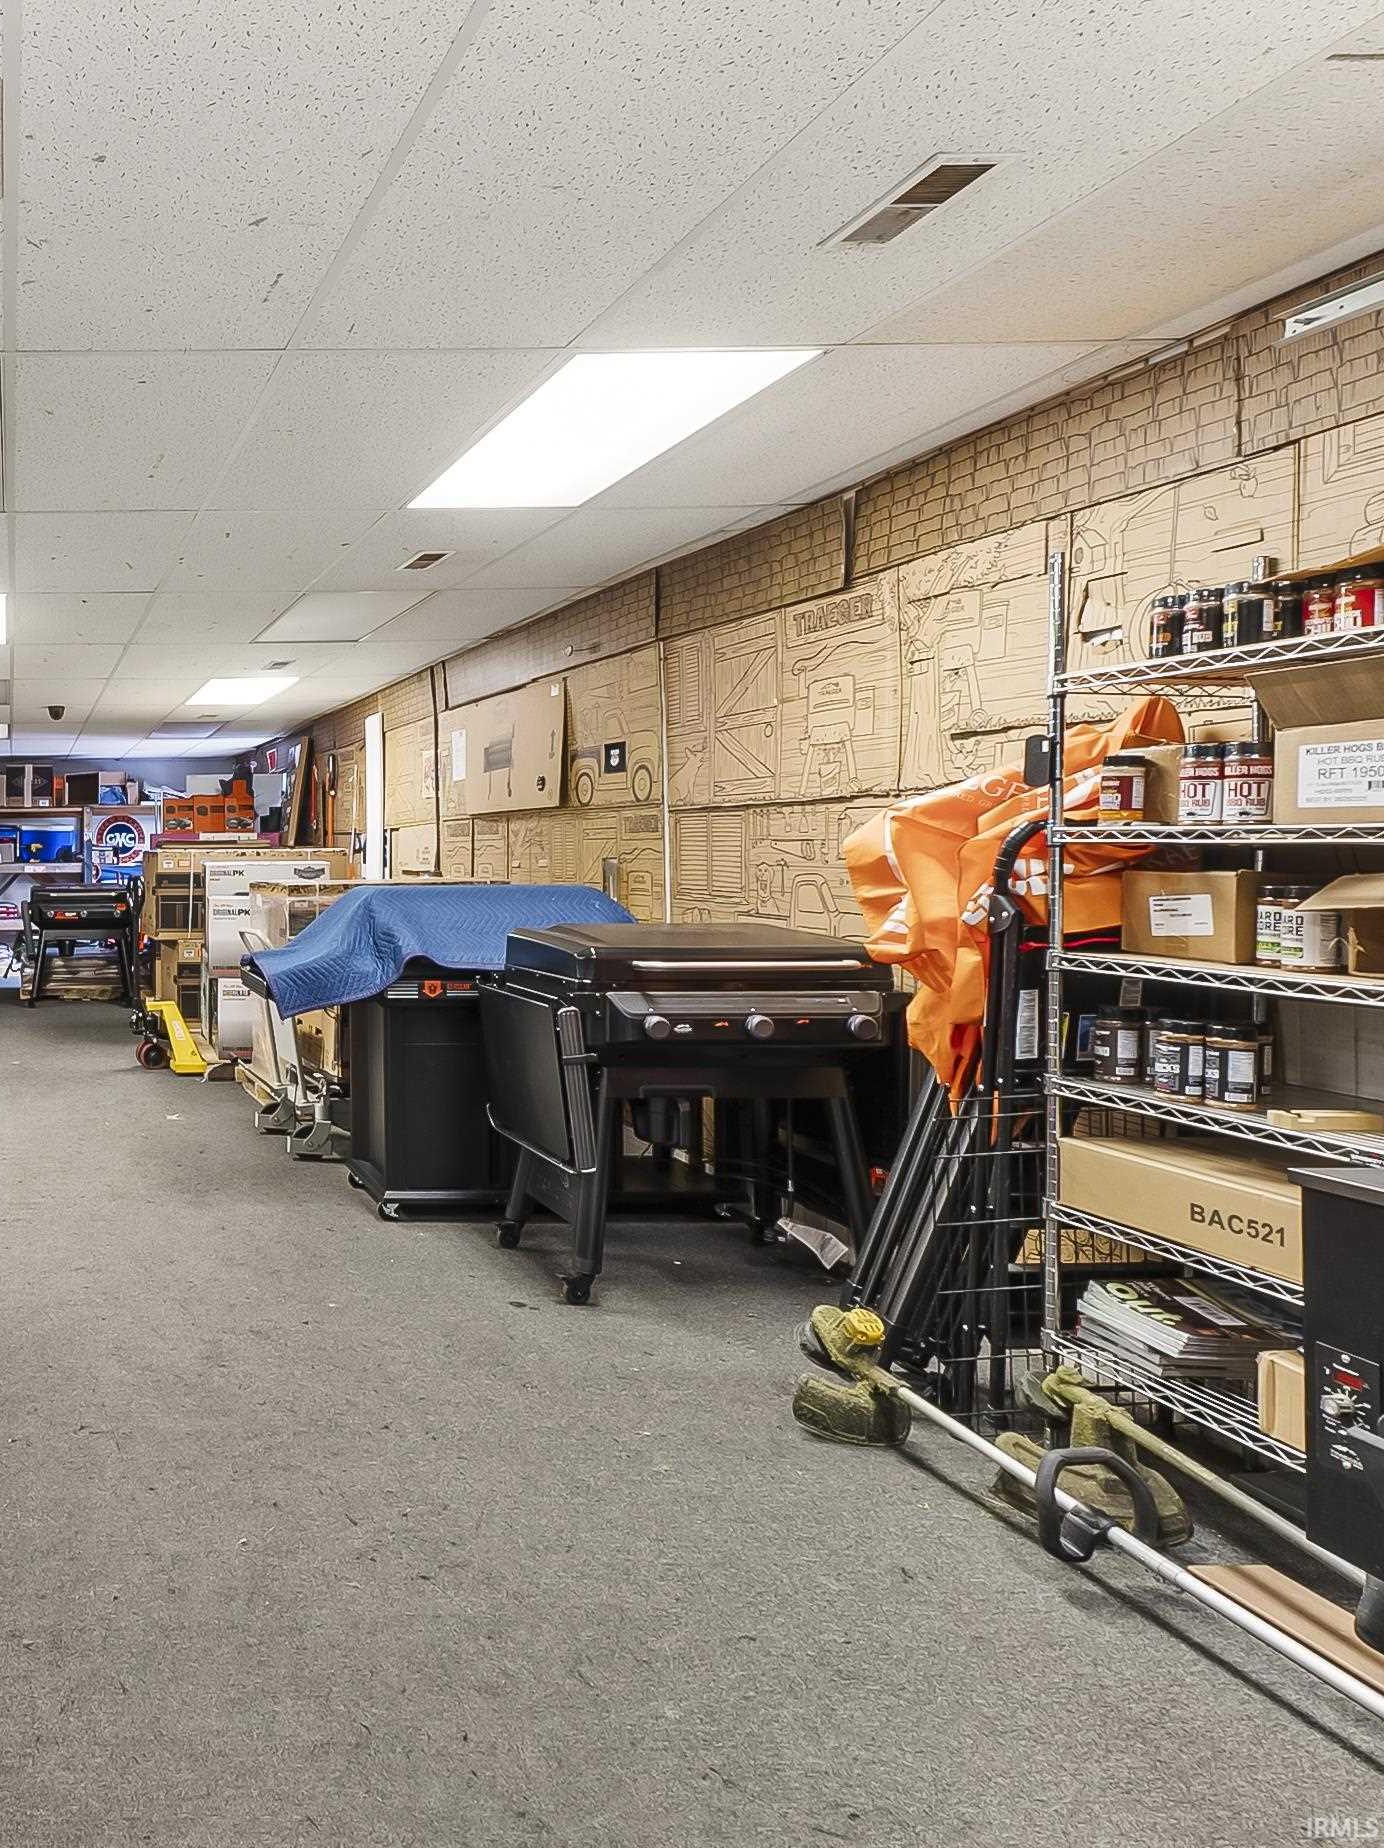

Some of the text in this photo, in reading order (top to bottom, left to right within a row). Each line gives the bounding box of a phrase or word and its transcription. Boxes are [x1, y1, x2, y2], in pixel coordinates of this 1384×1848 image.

[793, 593, 874, 638] TRAEGER
[1344, 743, 1373, 753] HOGS
[1318, 767, 1347, 780] RFT
[1228, 781, 1266, 798] HOT
[106, 832, 135, 848] GMC
[237, 908, 251, 916] PK
[1188, 1202, 1288, 1248] BAC521
